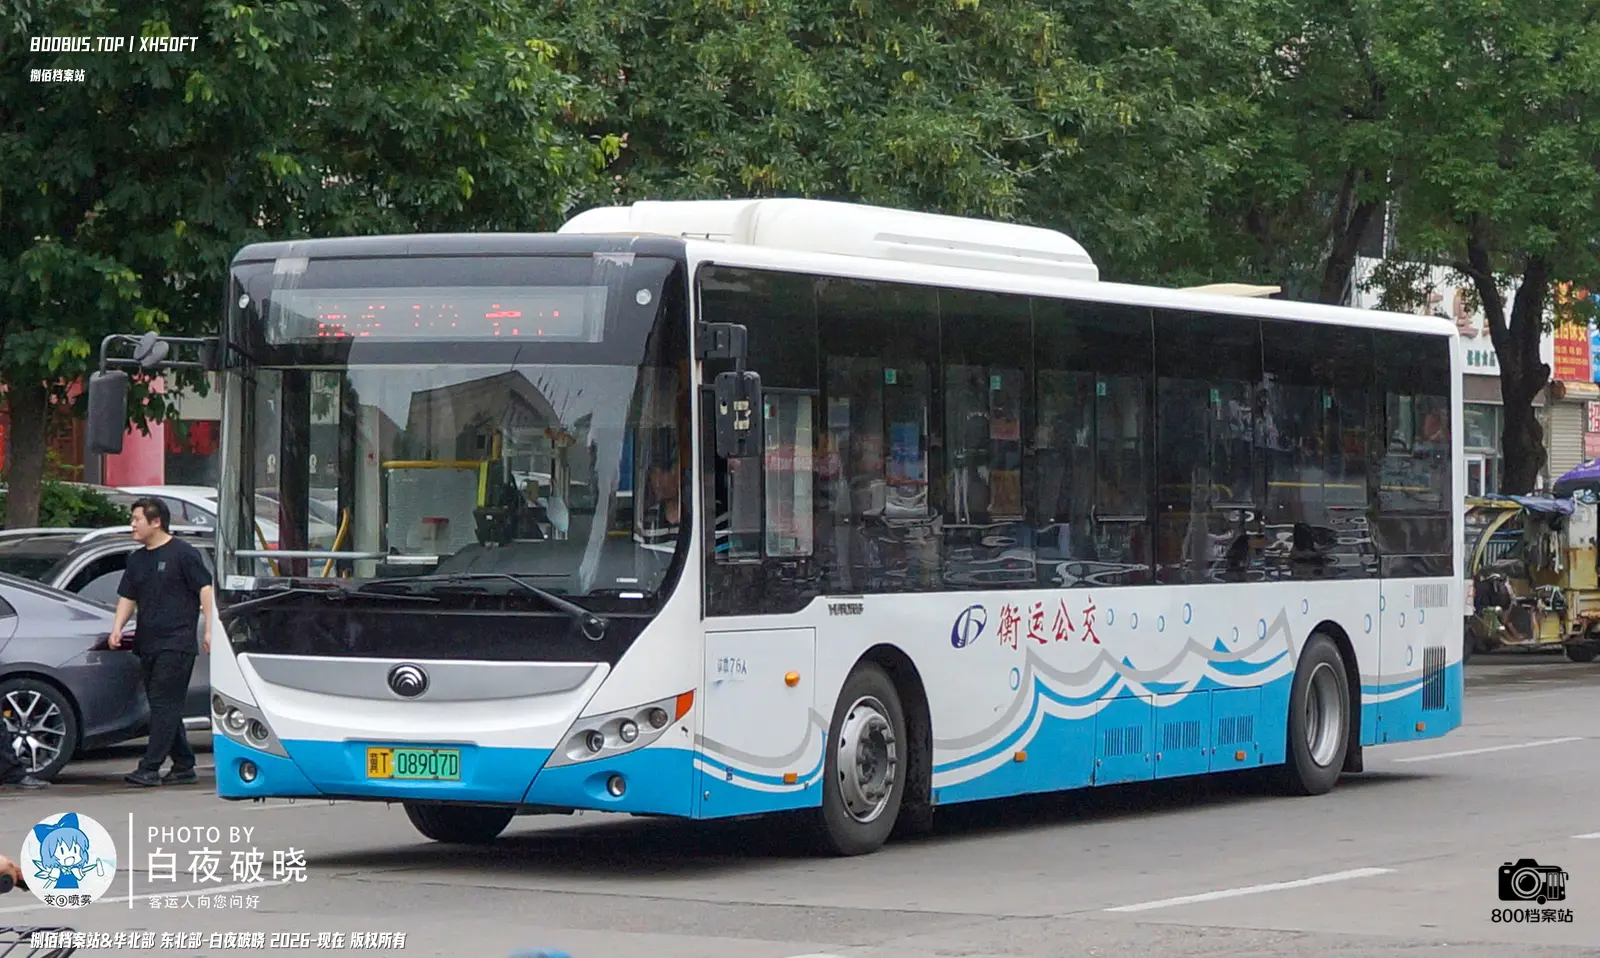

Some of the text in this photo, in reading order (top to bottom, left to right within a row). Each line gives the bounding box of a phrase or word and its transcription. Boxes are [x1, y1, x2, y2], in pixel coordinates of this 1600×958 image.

[996, 594, 1101, 650] 衡运公交
[398, 752, 458, 776] 08907D
